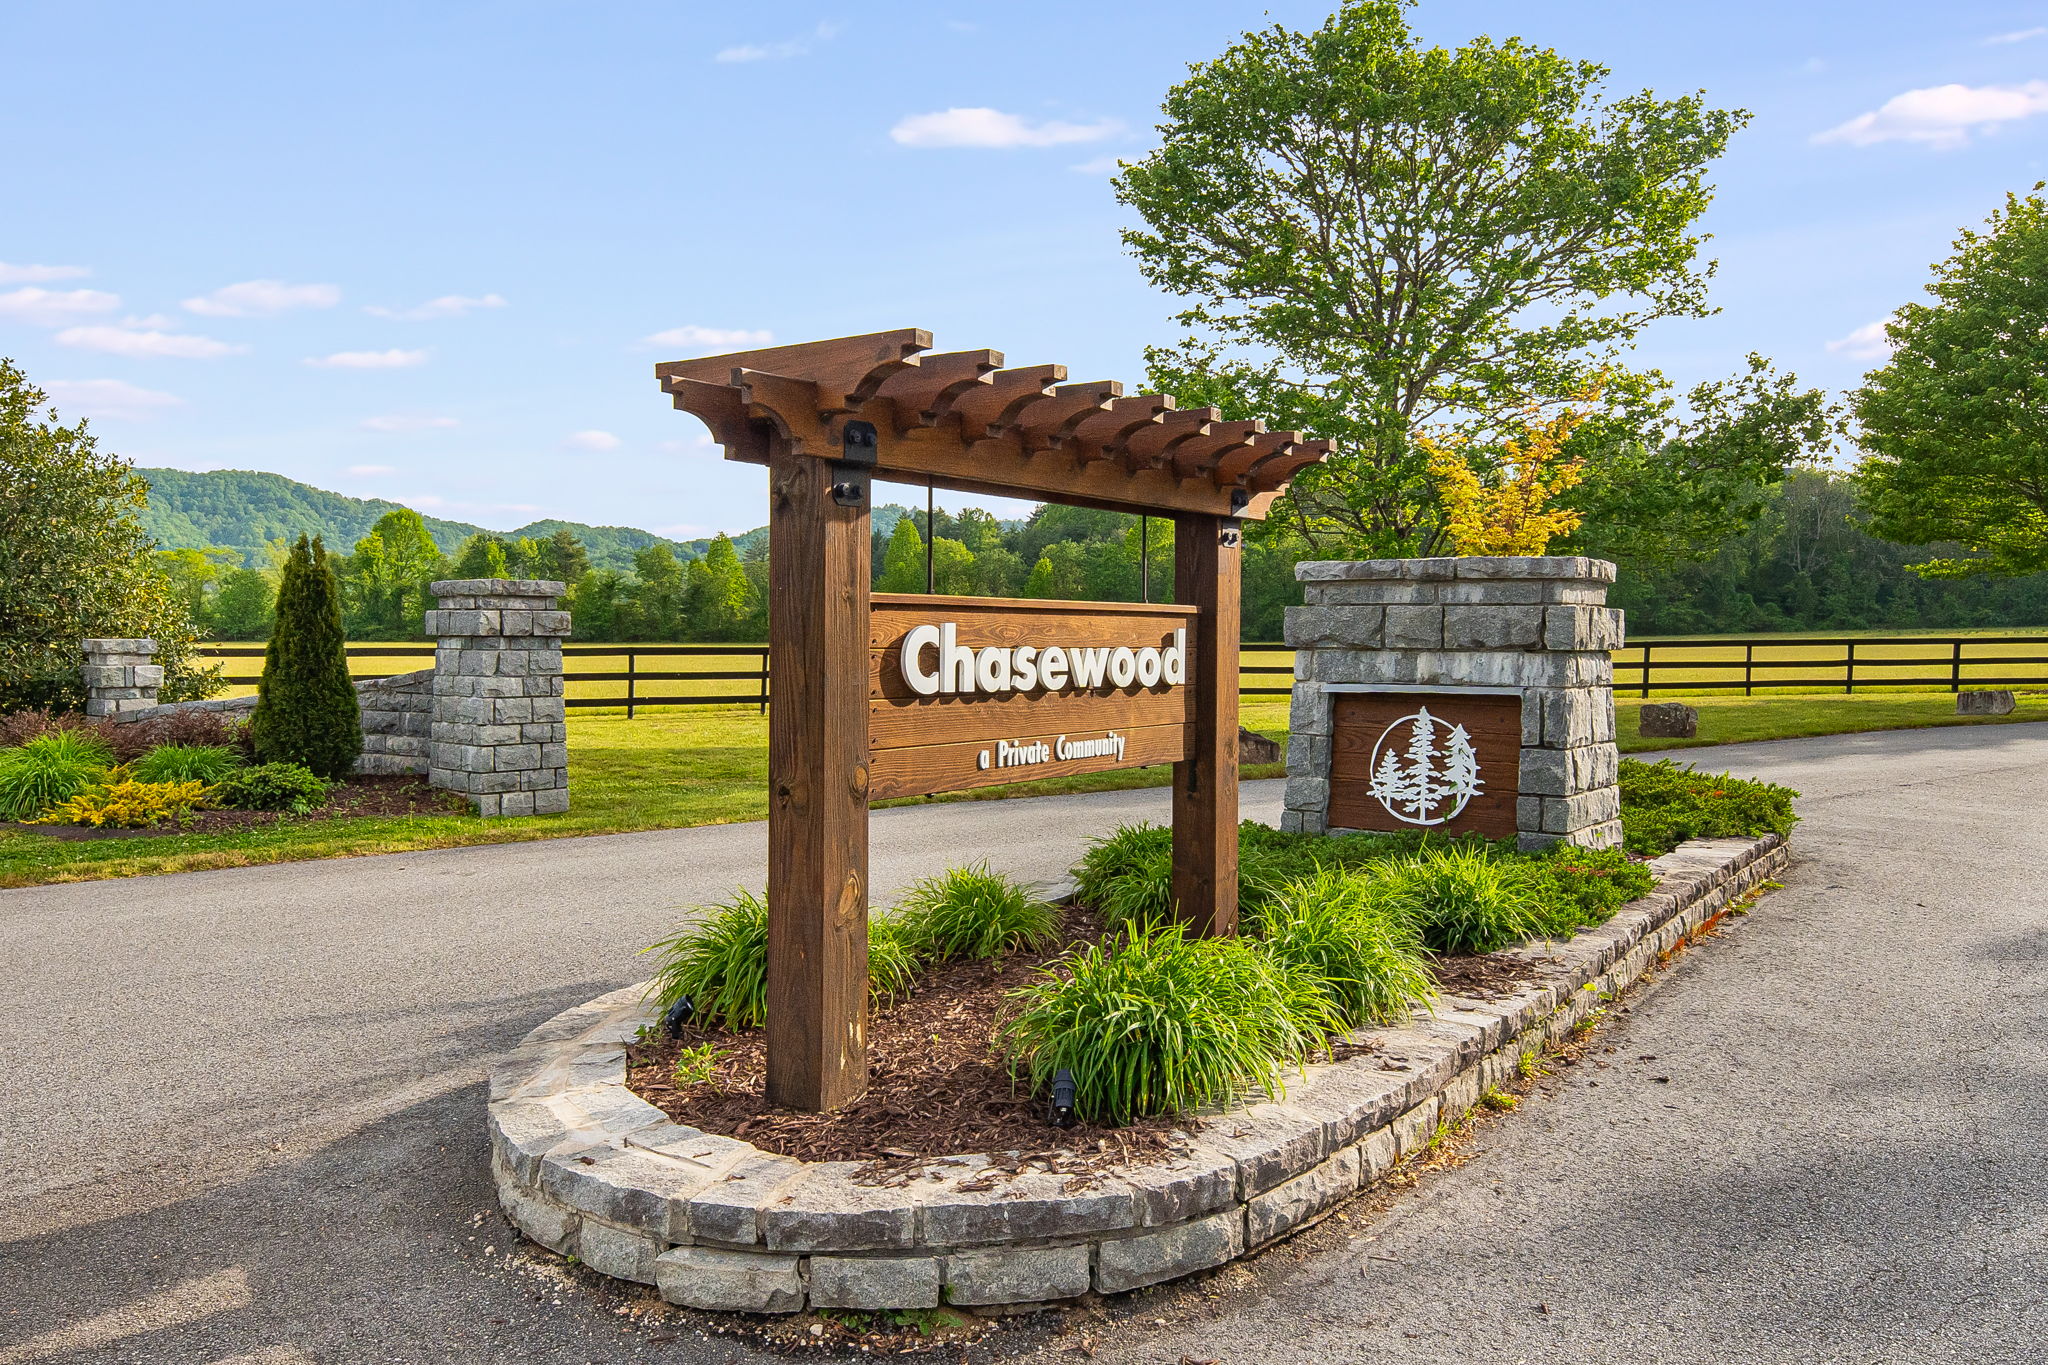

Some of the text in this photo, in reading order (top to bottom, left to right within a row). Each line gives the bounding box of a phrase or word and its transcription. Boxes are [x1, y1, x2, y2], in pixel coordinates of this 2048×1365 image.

[901, 622, 1186, 695] Chasewood
[979, 731, 1126, 770] a Private Community
